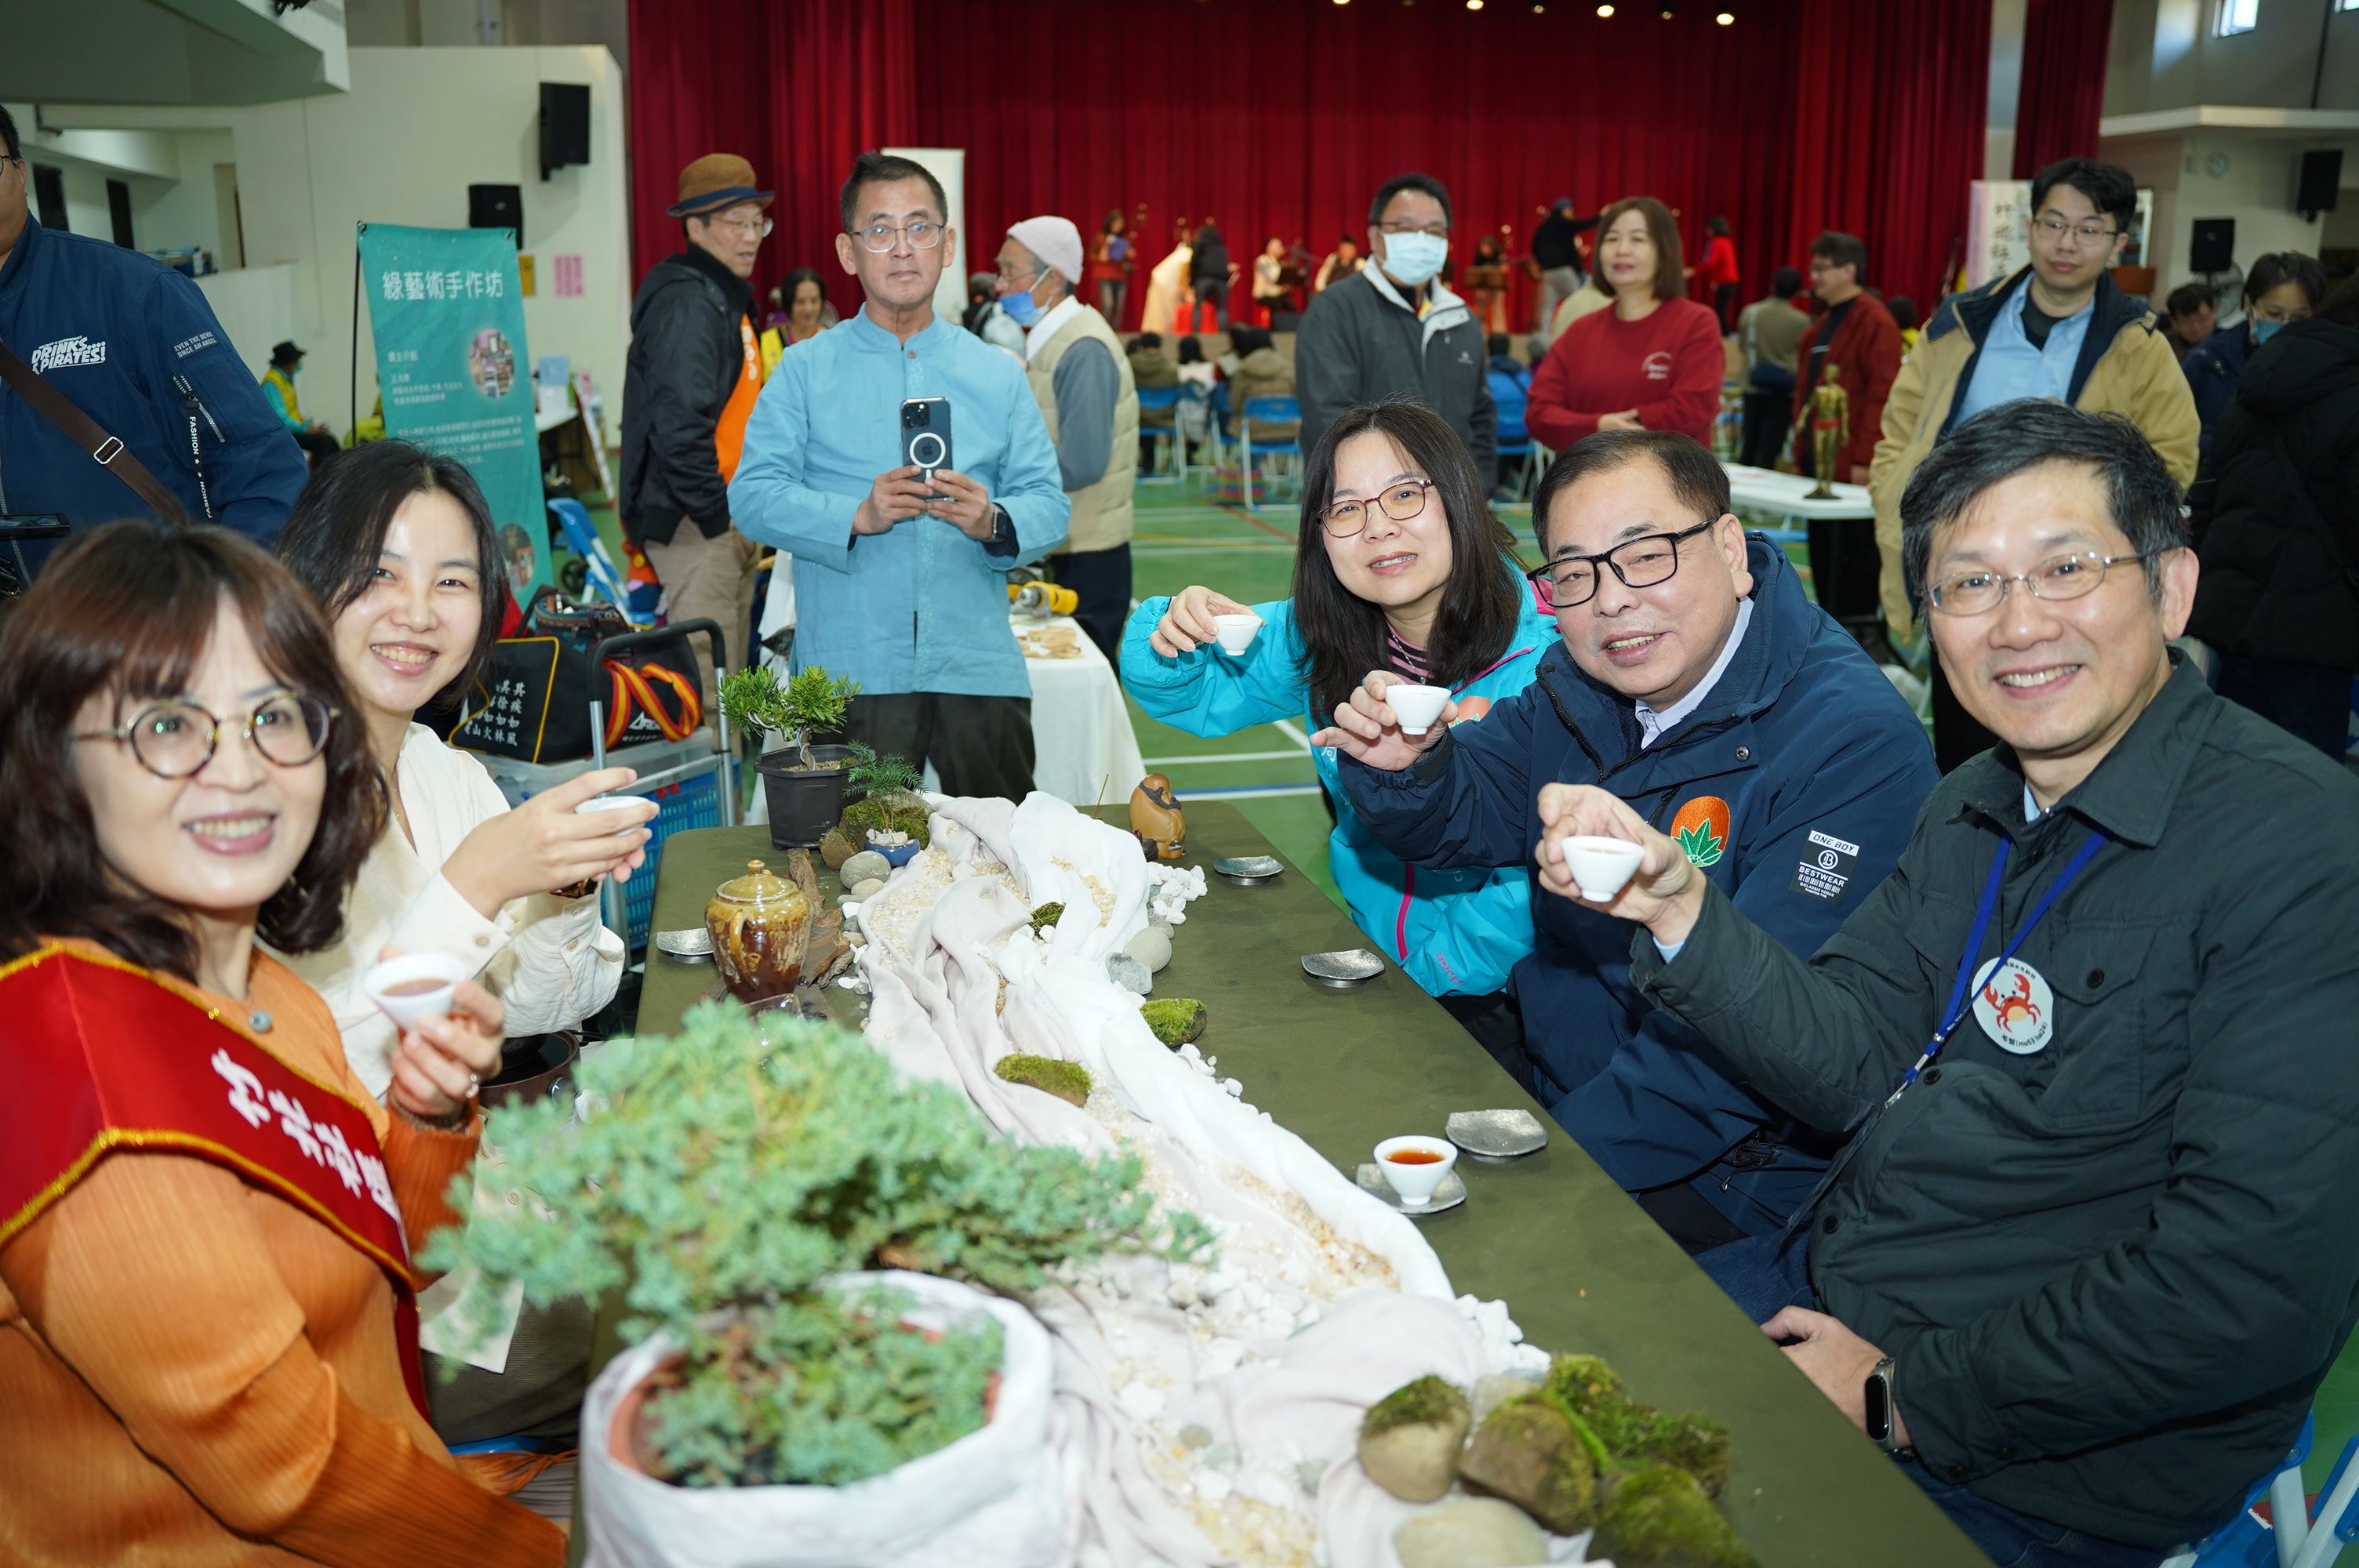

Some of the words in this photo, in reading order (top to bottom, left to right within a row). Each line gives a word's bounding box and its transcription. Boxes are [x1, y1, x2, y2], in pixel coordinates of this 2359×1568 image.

[382, 270, 503, 300] 綠藝術手作坊
[174, 340, 189, 351] EVEN
[189, 336, 201, 344] THE
[177, 346, 194, 358] ONCE
[202, 337, 216, 347] ANGEL
[40, 346, 106, 373] PIRATES!
[190, 416, 199, 455] FASHION
[199, 481, 213, 518] FASHION
[1813, 833, 1834, 846] ONE
[1835, 841, 1854, 852] BOY
[1798, 866, 1845, 887] BESTWEAR
